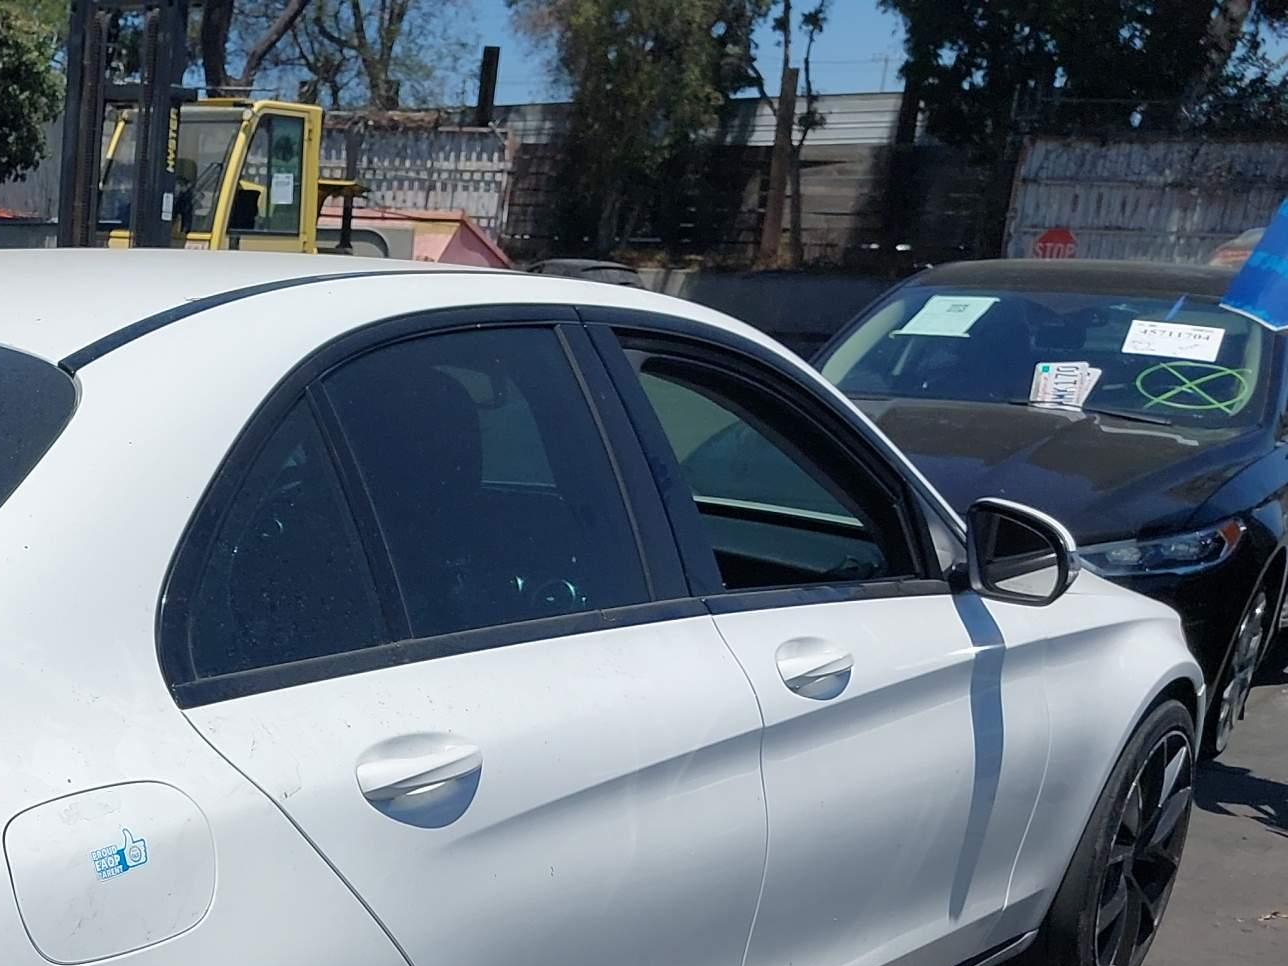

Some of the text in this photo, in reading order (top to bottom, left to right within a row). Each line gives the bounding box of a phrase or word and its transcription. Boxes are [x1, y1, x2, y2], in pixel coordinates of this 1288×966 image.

[166, 107, 178, 173] HYSTER
[1035, 243, 1075, 259] STOP
[91, 845, 118, 861] PROUD
